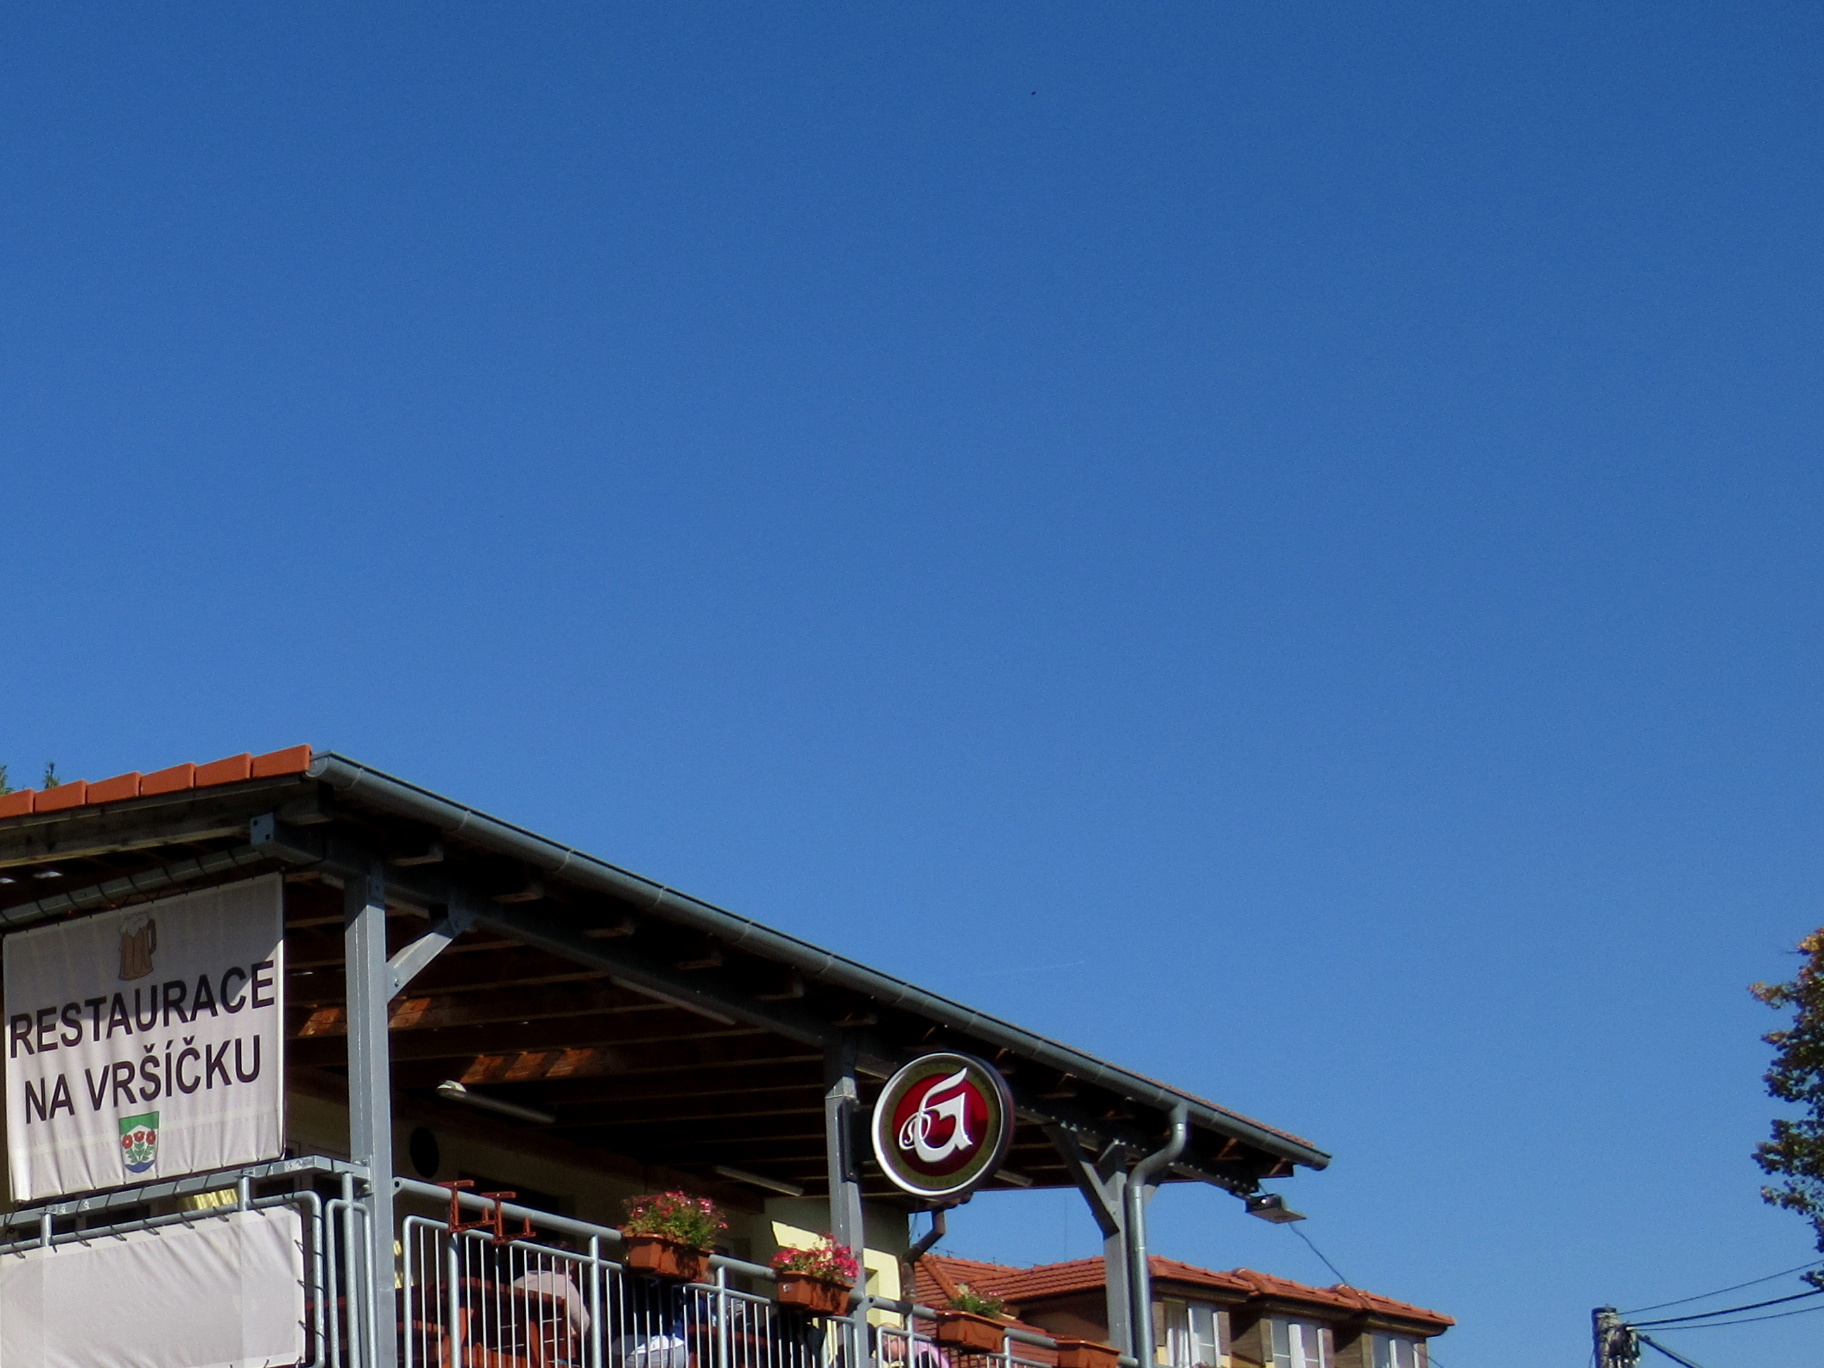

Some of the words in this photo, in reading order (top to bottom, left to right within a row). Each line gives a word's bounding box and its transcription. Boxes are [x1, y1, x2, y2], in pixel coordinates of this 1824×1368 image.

[10, 960, 275, 1058] RESTAURACE
[25, 1073, 75, 1124] NA
[85, 1034, 261, 1111] VRŠÍČKU
